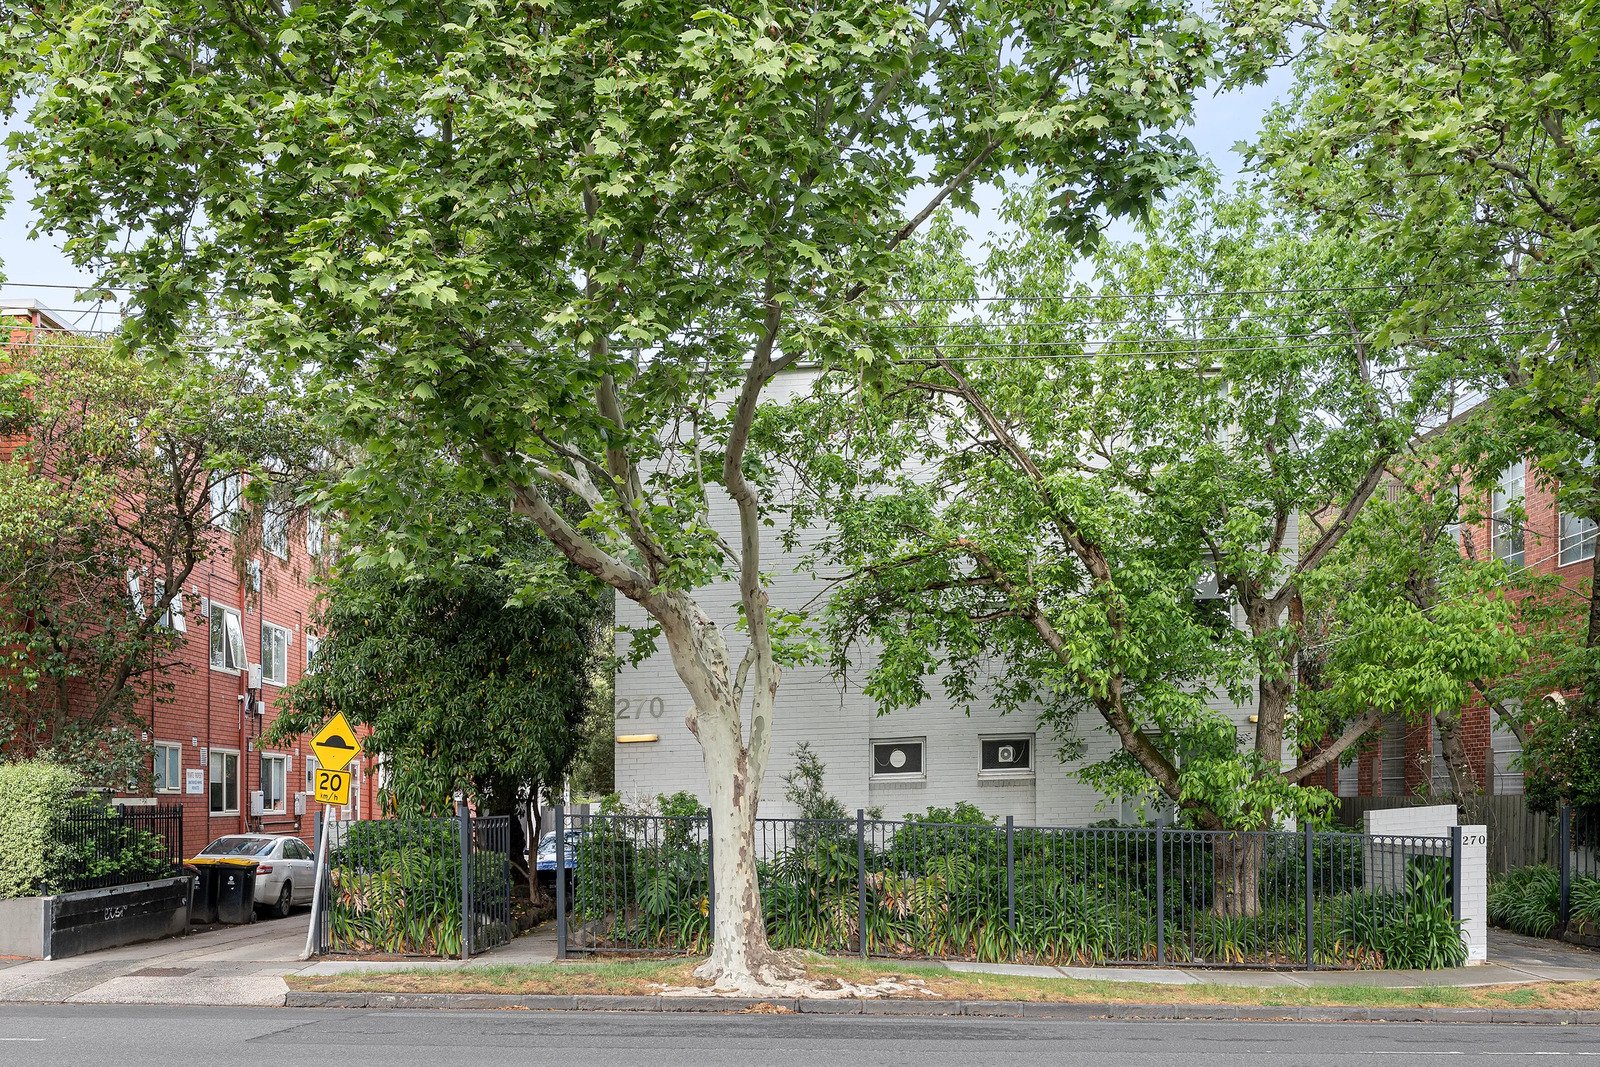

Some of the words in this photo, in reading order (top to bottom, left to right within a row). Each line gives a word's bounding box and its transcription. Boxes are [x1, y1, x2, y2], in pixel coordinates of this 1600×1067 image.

[616, 696, 664, 719] 270
[320, 773, 341, 791] 20
[1462, 835, 1485, 845] 270
